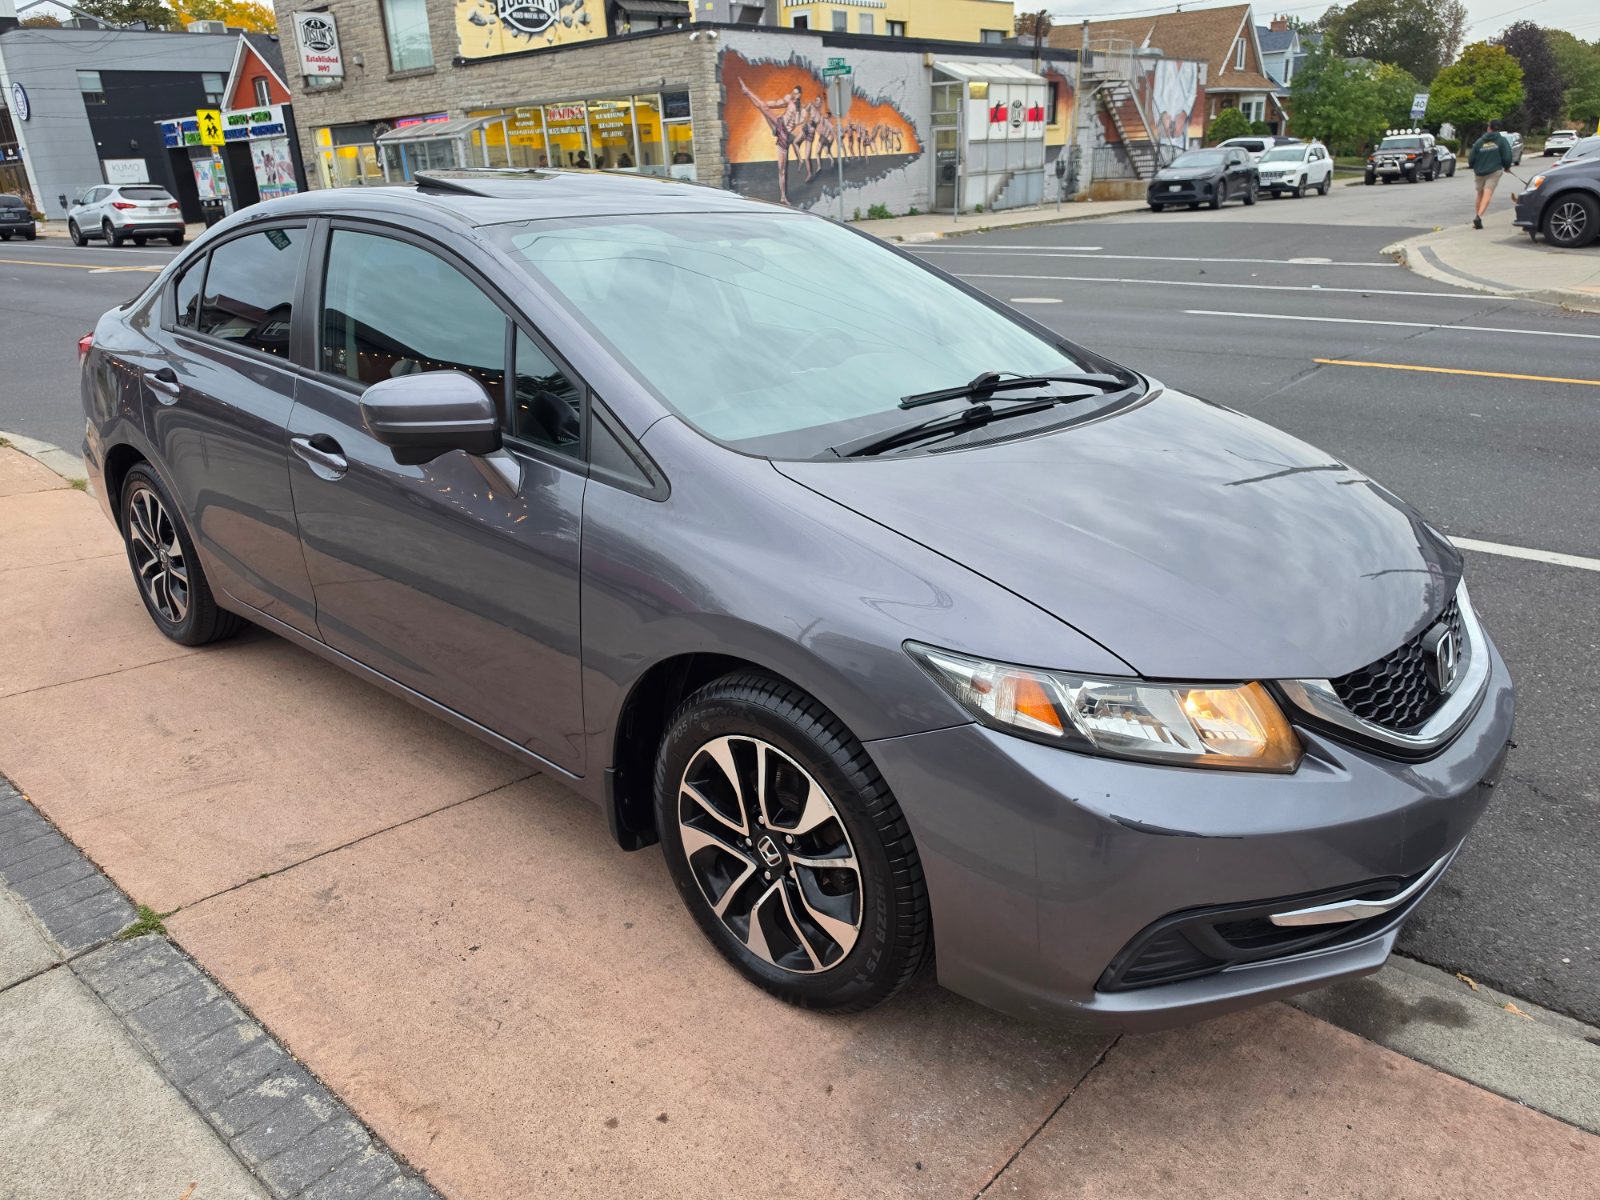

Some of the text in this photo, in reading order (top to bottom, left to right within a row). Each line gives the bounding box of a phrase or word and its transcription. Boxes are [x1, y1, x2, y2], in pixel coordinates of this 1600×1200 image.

[299, 21, 335, 48] JOSLIN'S
[305, 54, 339, 63] Established
[1415, 100, 1425, 108] 40
[111, 162, 140, 173] KUMO
